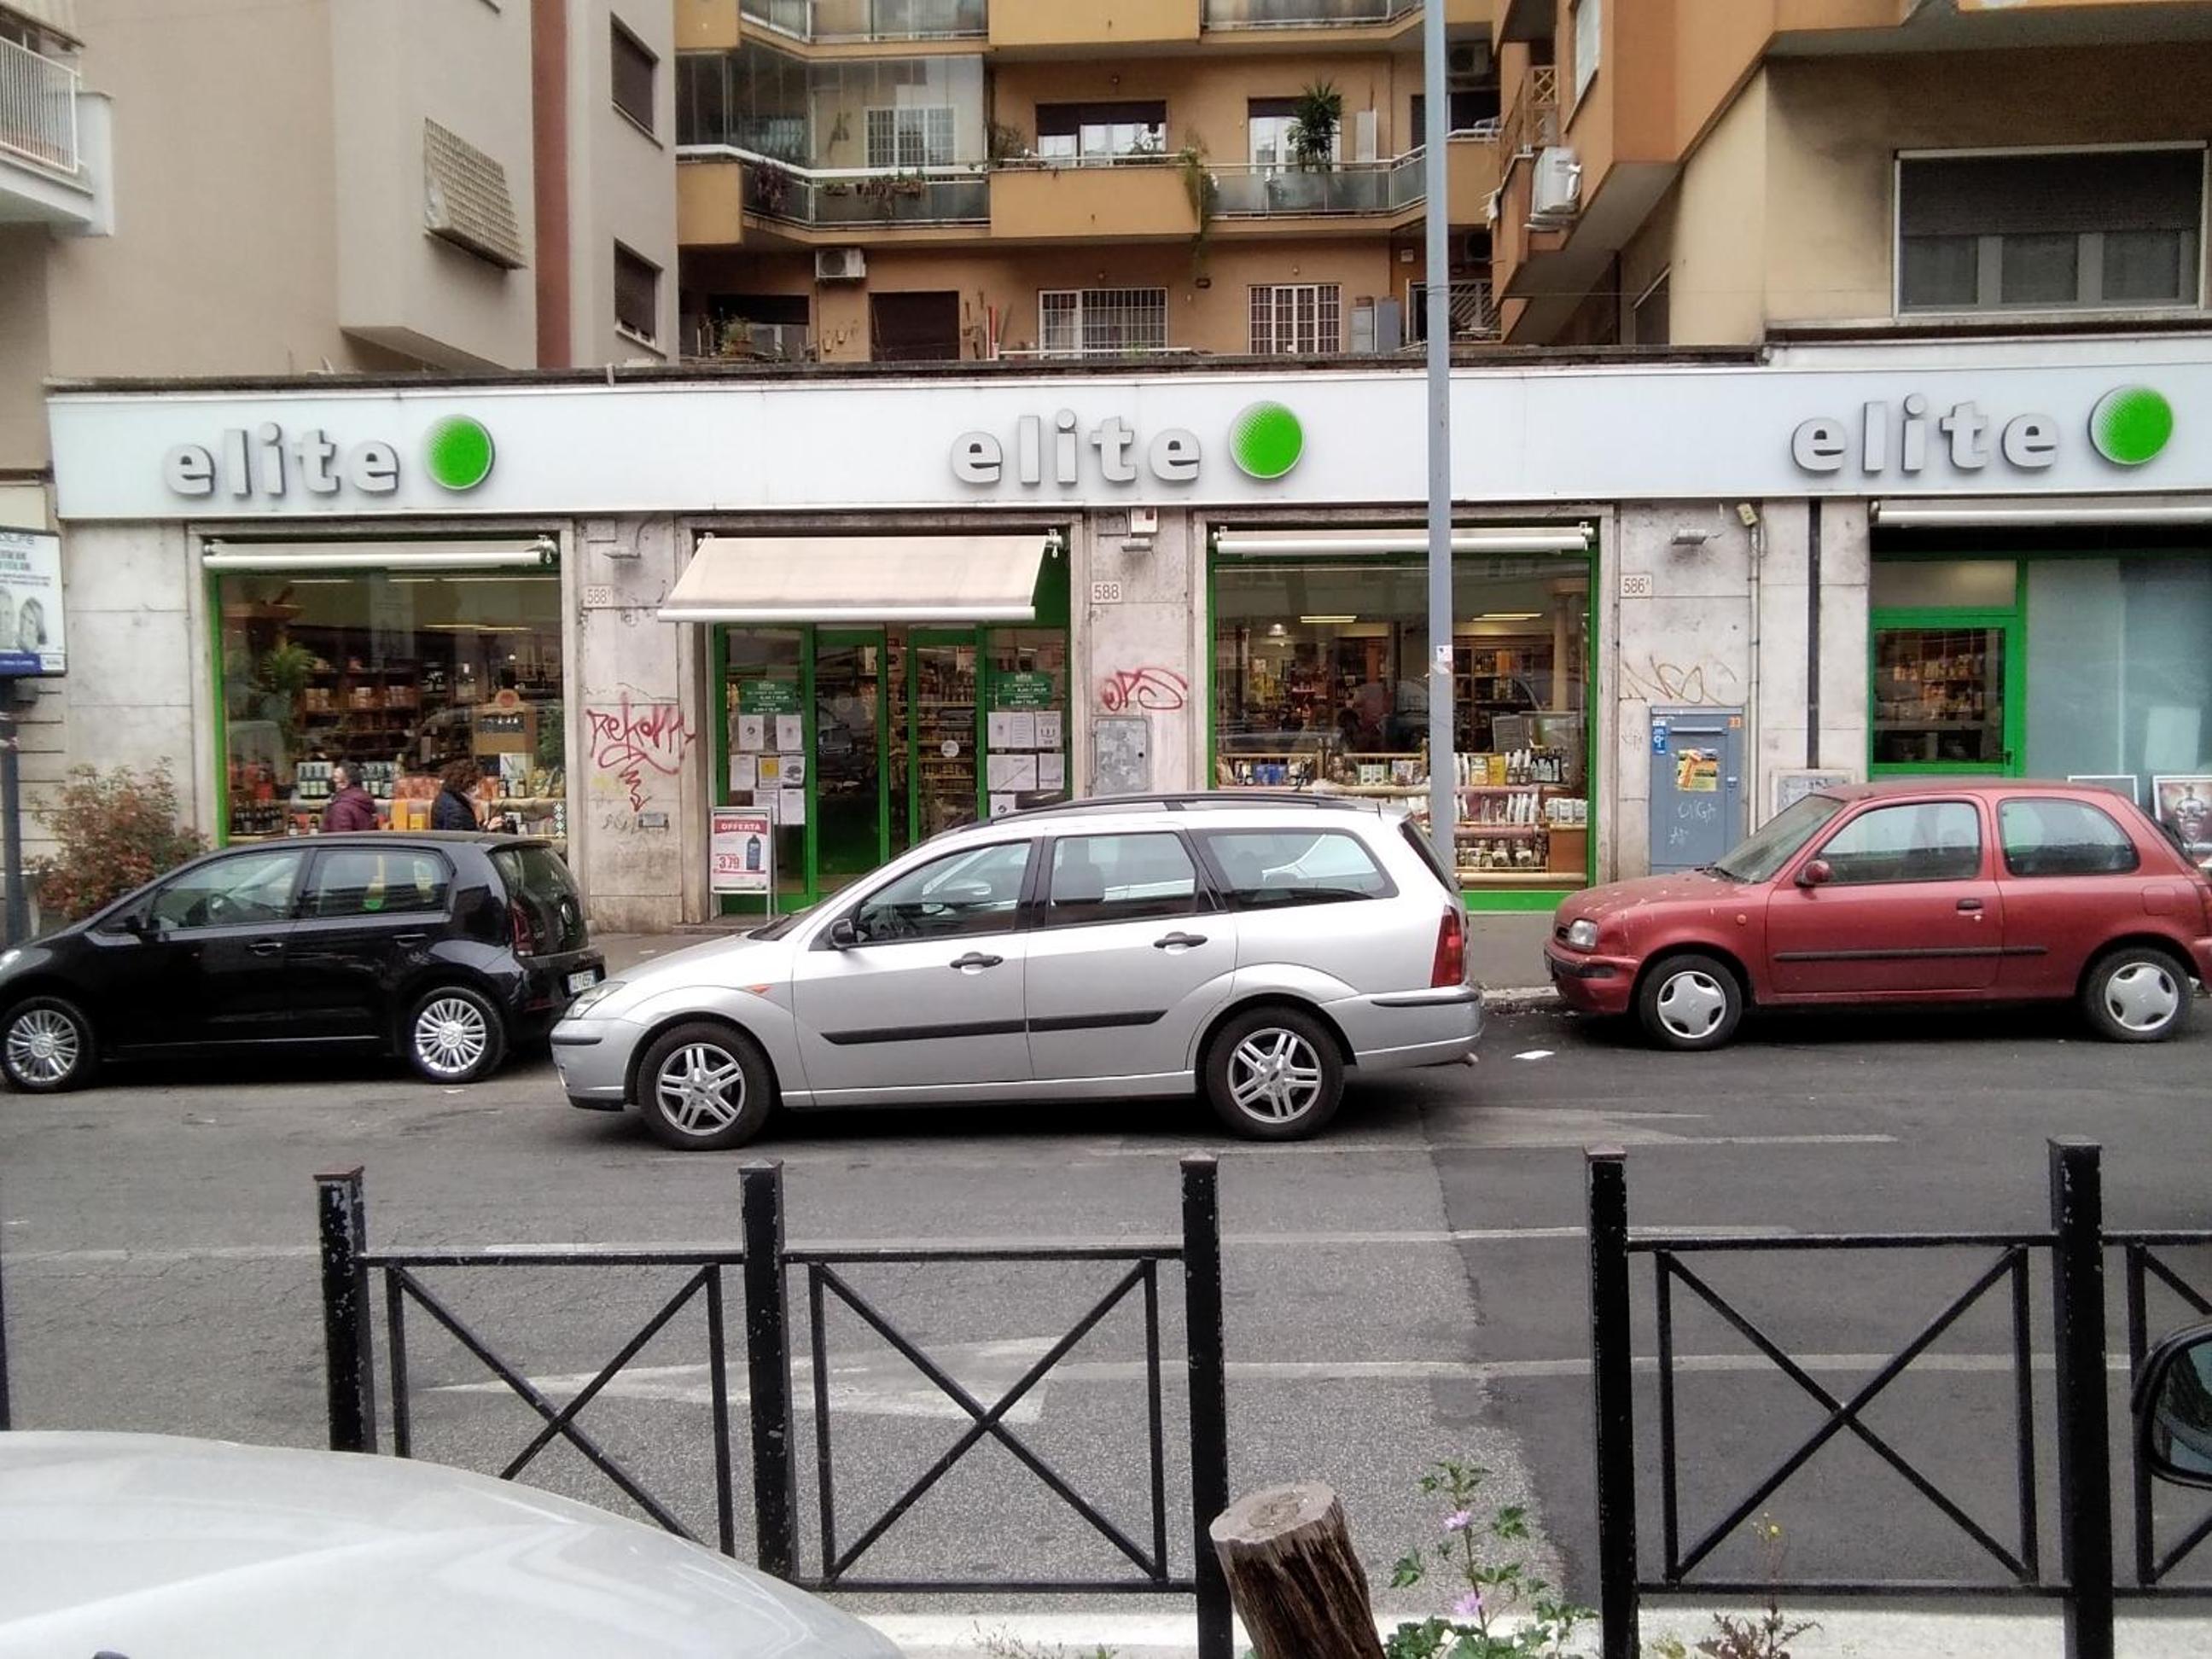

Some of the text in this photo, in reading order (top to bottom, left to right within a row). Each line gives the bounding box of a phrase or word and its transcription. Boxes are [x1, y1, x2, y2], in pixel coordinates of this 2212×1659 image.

[166, 422, 399, 496] elite
[950, 409, 1202, 484] elite
[1792, 393, 2059, 472] elite
[1094, 584, 1119, 599] 588
